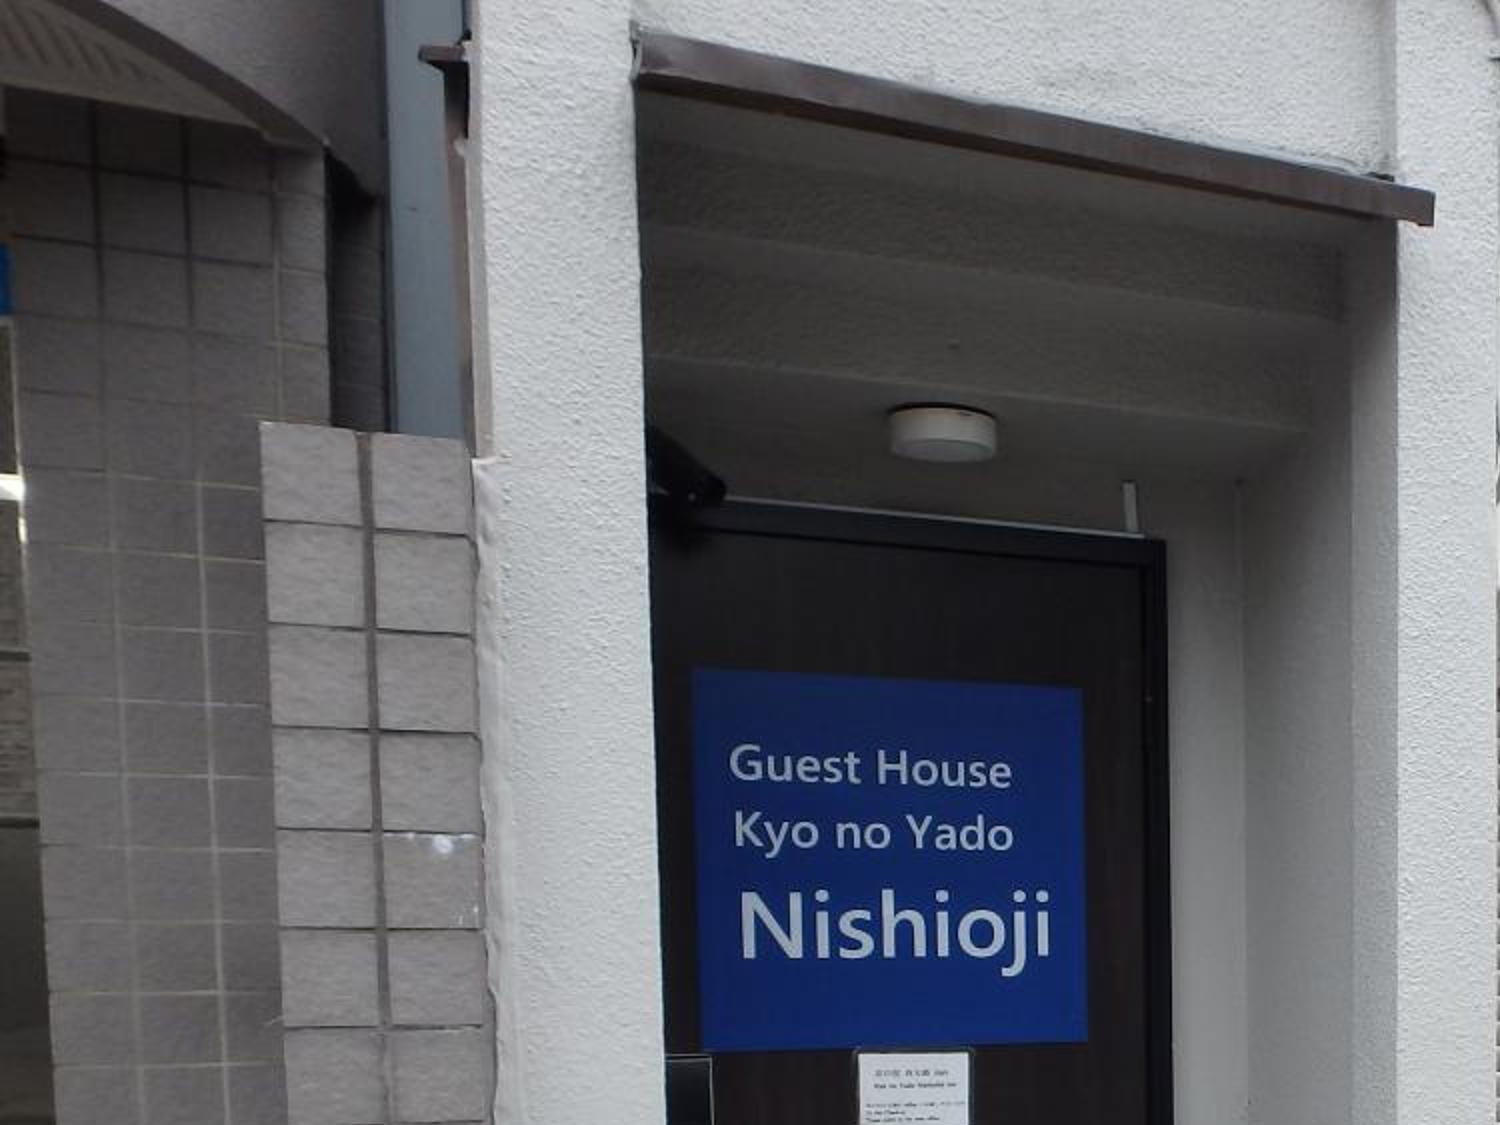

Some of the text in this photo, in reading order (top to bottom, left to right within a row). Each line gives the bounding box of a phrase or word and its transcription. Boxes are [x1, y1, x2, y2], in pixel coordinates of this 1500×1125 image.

[729, 743, 1013, 789] Guest House
[734, 810, 1014, 859] Kyo no Yado
[740, 888, 1050, 978] Nishioji
